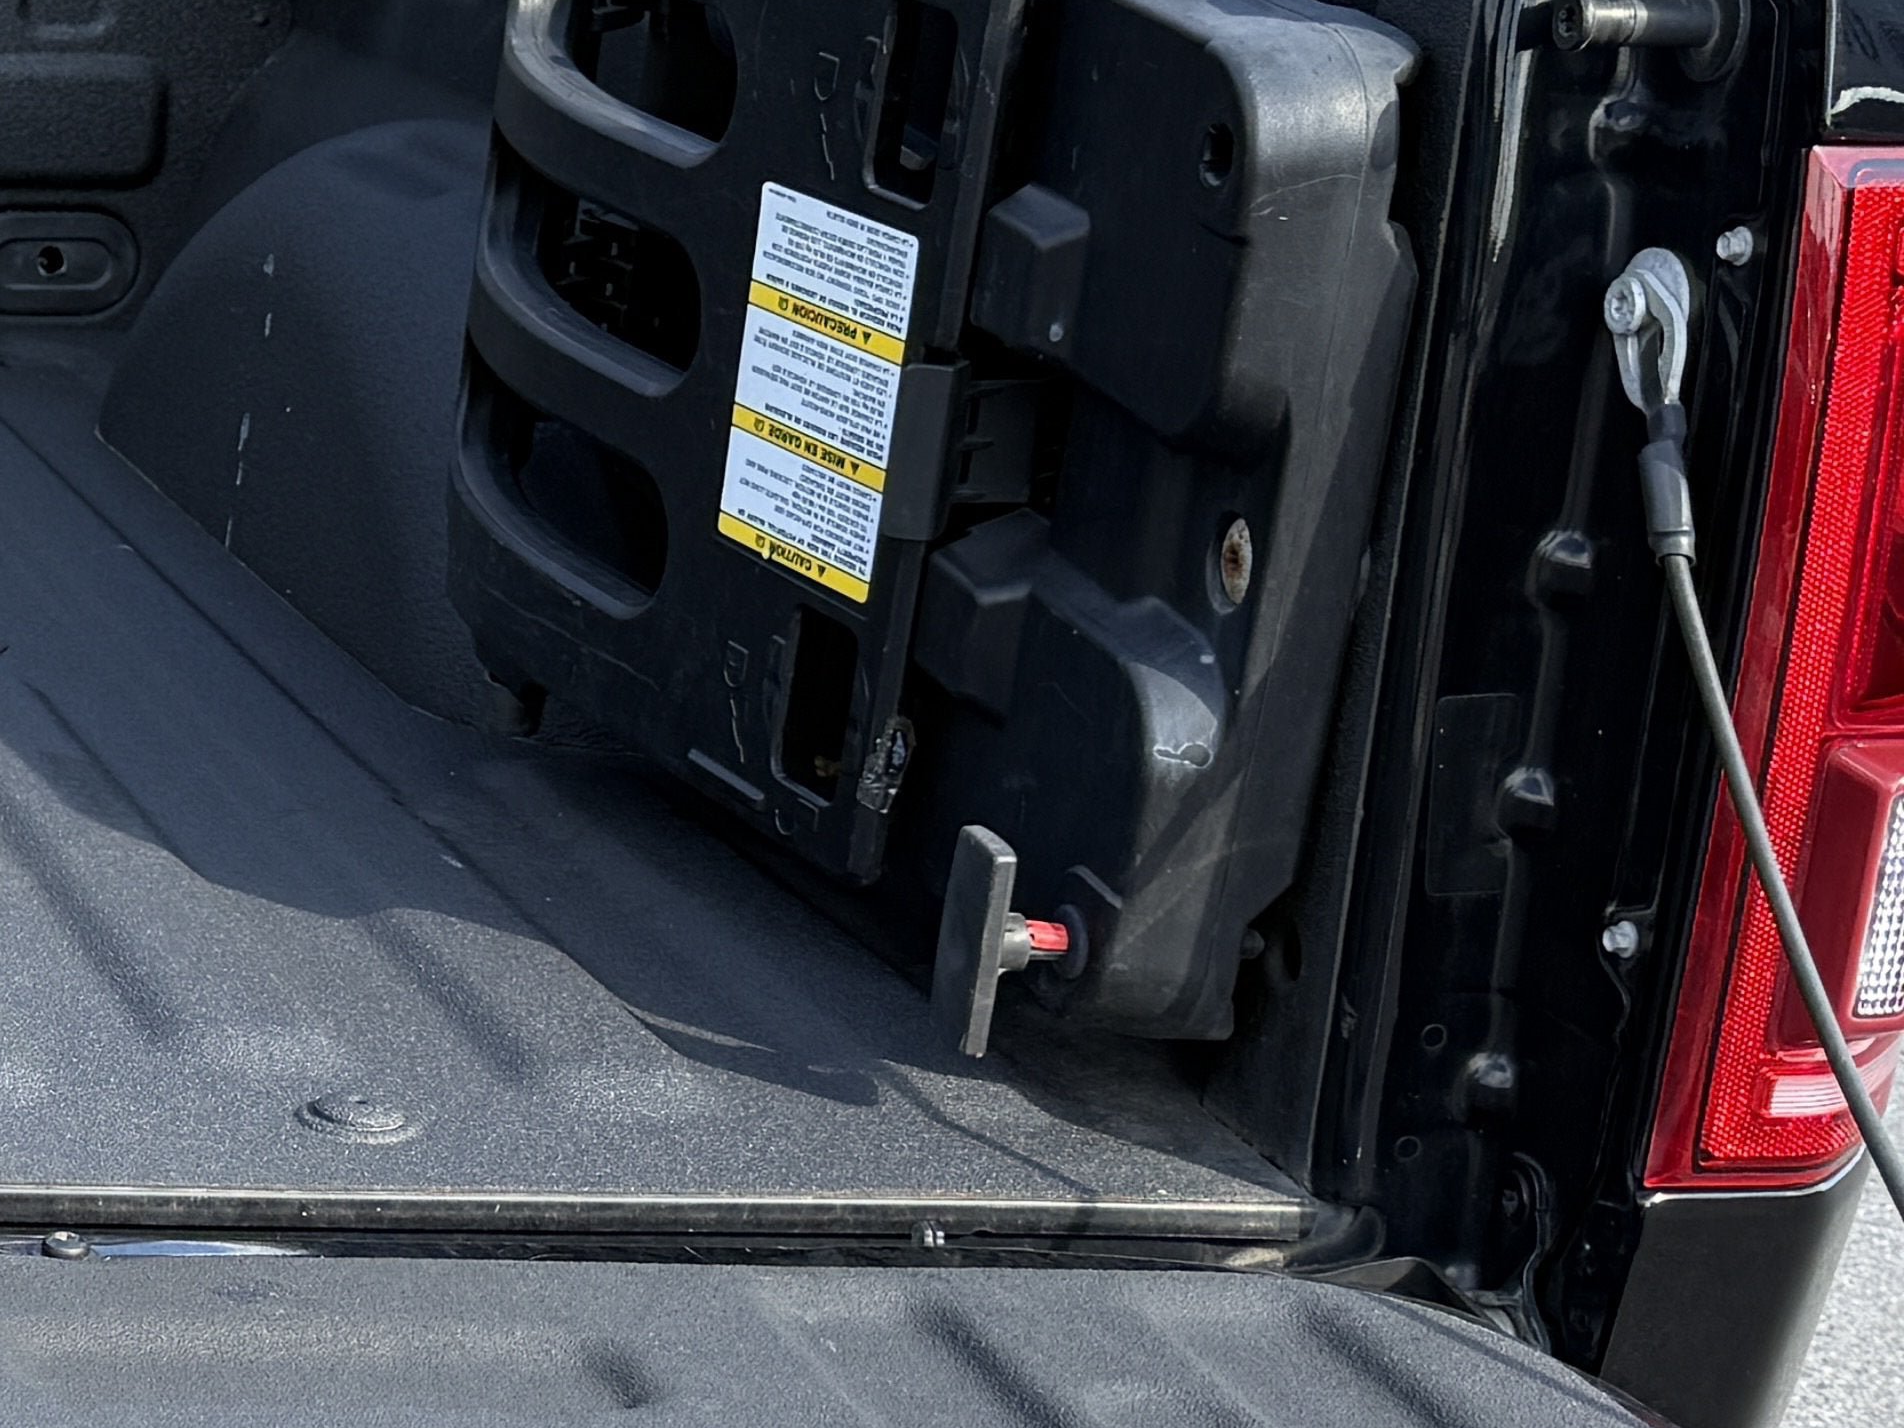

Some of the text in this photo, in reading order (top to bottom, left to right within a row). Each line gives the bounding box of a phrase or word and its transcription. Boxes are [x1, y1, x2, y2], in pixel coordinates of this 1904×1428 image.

[768, 423, 845, 468] MISE EN GARDE
[769, 540, 811, 569] CAUTION
